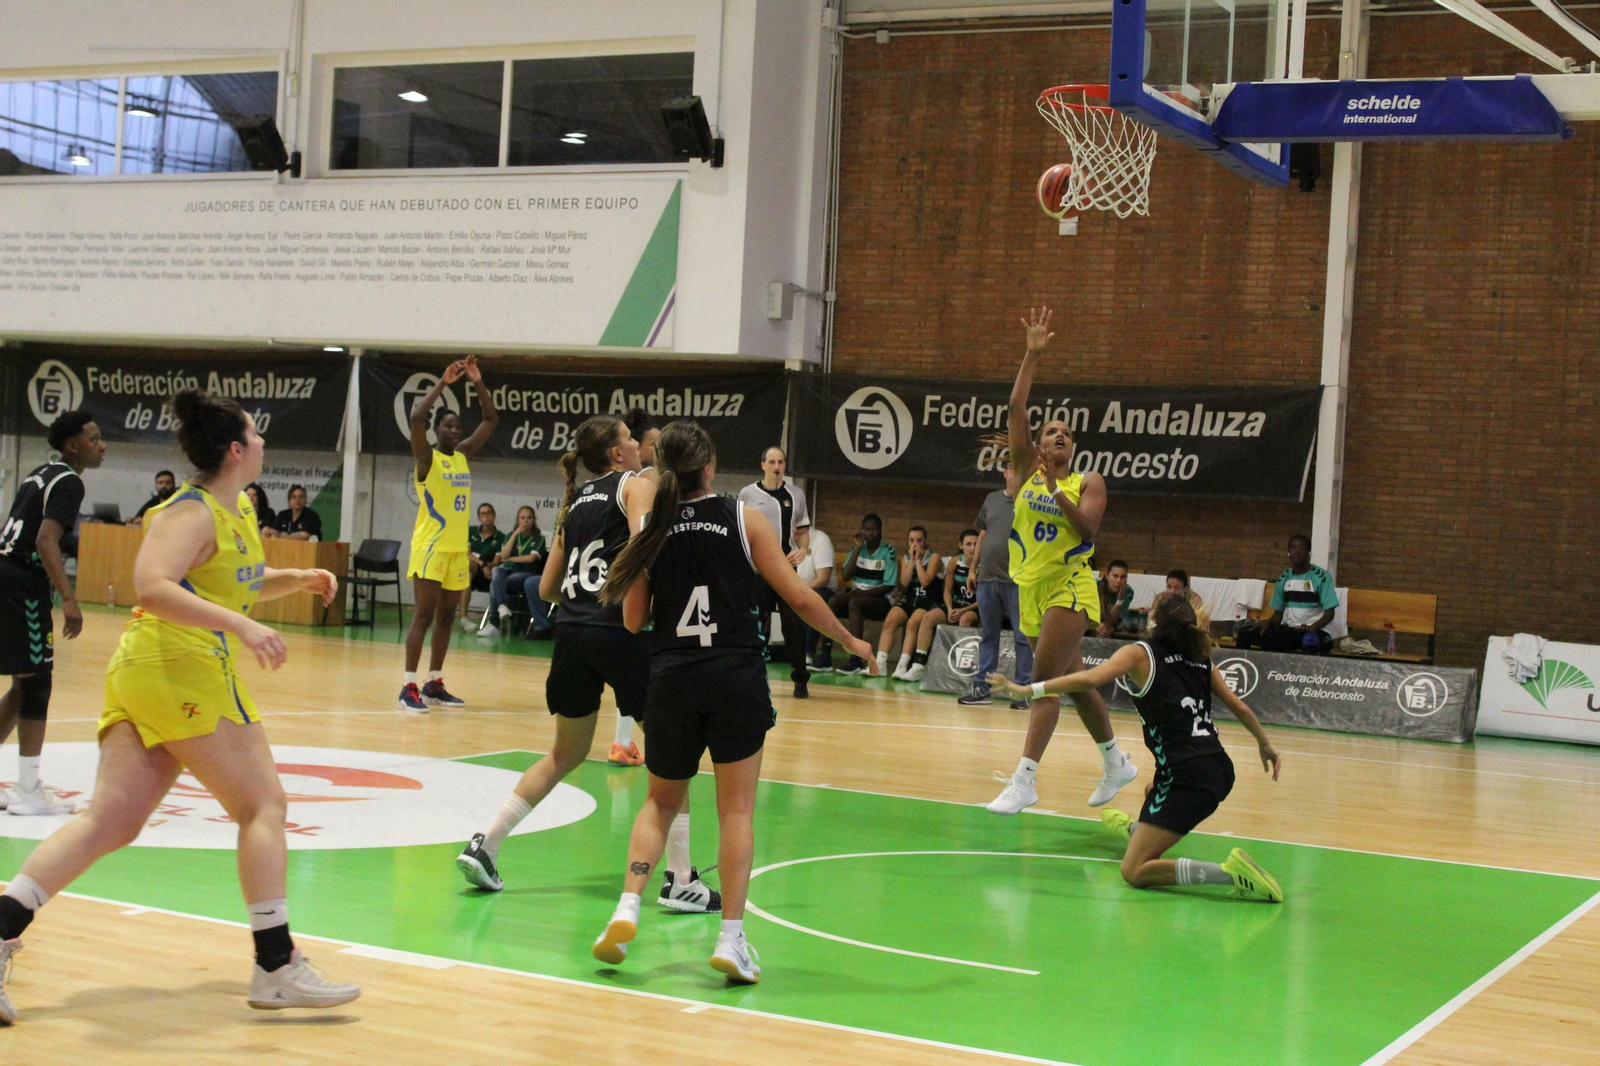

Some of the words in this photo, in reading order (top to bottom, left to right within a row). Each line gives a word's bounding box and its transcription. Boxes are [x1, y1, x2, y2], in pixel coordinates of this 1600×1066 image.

[1347, 95, 1421, 110] schelde
[1343, 114, 1417, 124] international
[184, 200, 255, 212] JUGADORES
[259, 200, 275, 212] DE
[279, 199, 336, 212] CANTERA
[339, 199, 365, 211] QUE
[370, 199, 395, 211] HAN
[400, 198, 470, 211] DEBUTADO
[474, 198, 502, 210] CON
[507, 198, 522, 210] EL
[528, 197, 579, 210] PRIMER
[585, 197, 639, 210] EQUIPO
[284, 231, 301, 240] Pedro
[303, 231, 322, 240] García
[327, 231, 354, 240] Armando
[355, 231, 379, 242] Nogués
[383, 231, 398, 240] Juan
[400, 231, 423, 240] Antonio
[449, 231, 469, 239] Emilio
[470, 231, 491, 239] Osuna
[496, 231, 513, 239] Paco
[514, 231, 540, 239] Cabello
[545, 231, 567, 241] Miguel
[568, 231, 588, 239] Pérez
[280, 245, 299, 255] Miguel
[379, 245, 401, 253] Manolo
[426, 245, 449, 253] Antonio
[480, 245, 502, 254] Rafael
[503, 245, 525, 254] Ibáñez
[530, 245, 546, 254] José
[558, 245, 572, 254] Mur
[299, 259, 316, 267] David
[331, 259, 353, 267] Manolo
[354, 259, 371, 267] Pérez
[399, 259, 415, 269] Mayo
[497, 260, 521, 268] Gabriel
[526, 260, 544, 268] Manu
[545, 260, 570, 268] Gómez
[296, 273, 319, 282] Augusto
[321, 273, 336, 281] Lima
[340, 273, 357, 281] Pablo
[390, 273, 409, 281] Carlos
[410, 273, 418, 281] de
[420, 273, 440, 281] Cobos
[446, 273, 462, 284] Pepe
[464, 273, 483, 282] Pozas
[489, 274, 511, 282] Alberto
[548, 274, 574, 283] Abrines
[87, 366, 199, 398] Federación
[206, 372, 318, 399] Andaluza
[464, 381, 600, 415] Fderación
[608, 389, 745, 418] Andaluza
[125, 402, 154, 431] de
[922, 394, 1090, 434] Federción
[1099, 400, 1266, 438] Andaluza
[511, 421, 541, 451] de
[454, 494, 467, 512] 63
[535, 499, 541, 511] y
[543, 498, 555, 509] de
[1028, 501, 1064, 518] TENERIFE
[673, 522, 728, 537] ESTEPONA
[1034, 520, 1058, 542] 69
[561, 539, 609, 600] 46
[914, 586, 927, 597] 15
[676, 585, 718, 648] 4
[1267, 671, 1330, 689] Federación
[1331, 676, 1389, 694] Andaluza
[1285, 686, 1299, 697] de
[1302, 687, 1365, 703] Baloncesto
